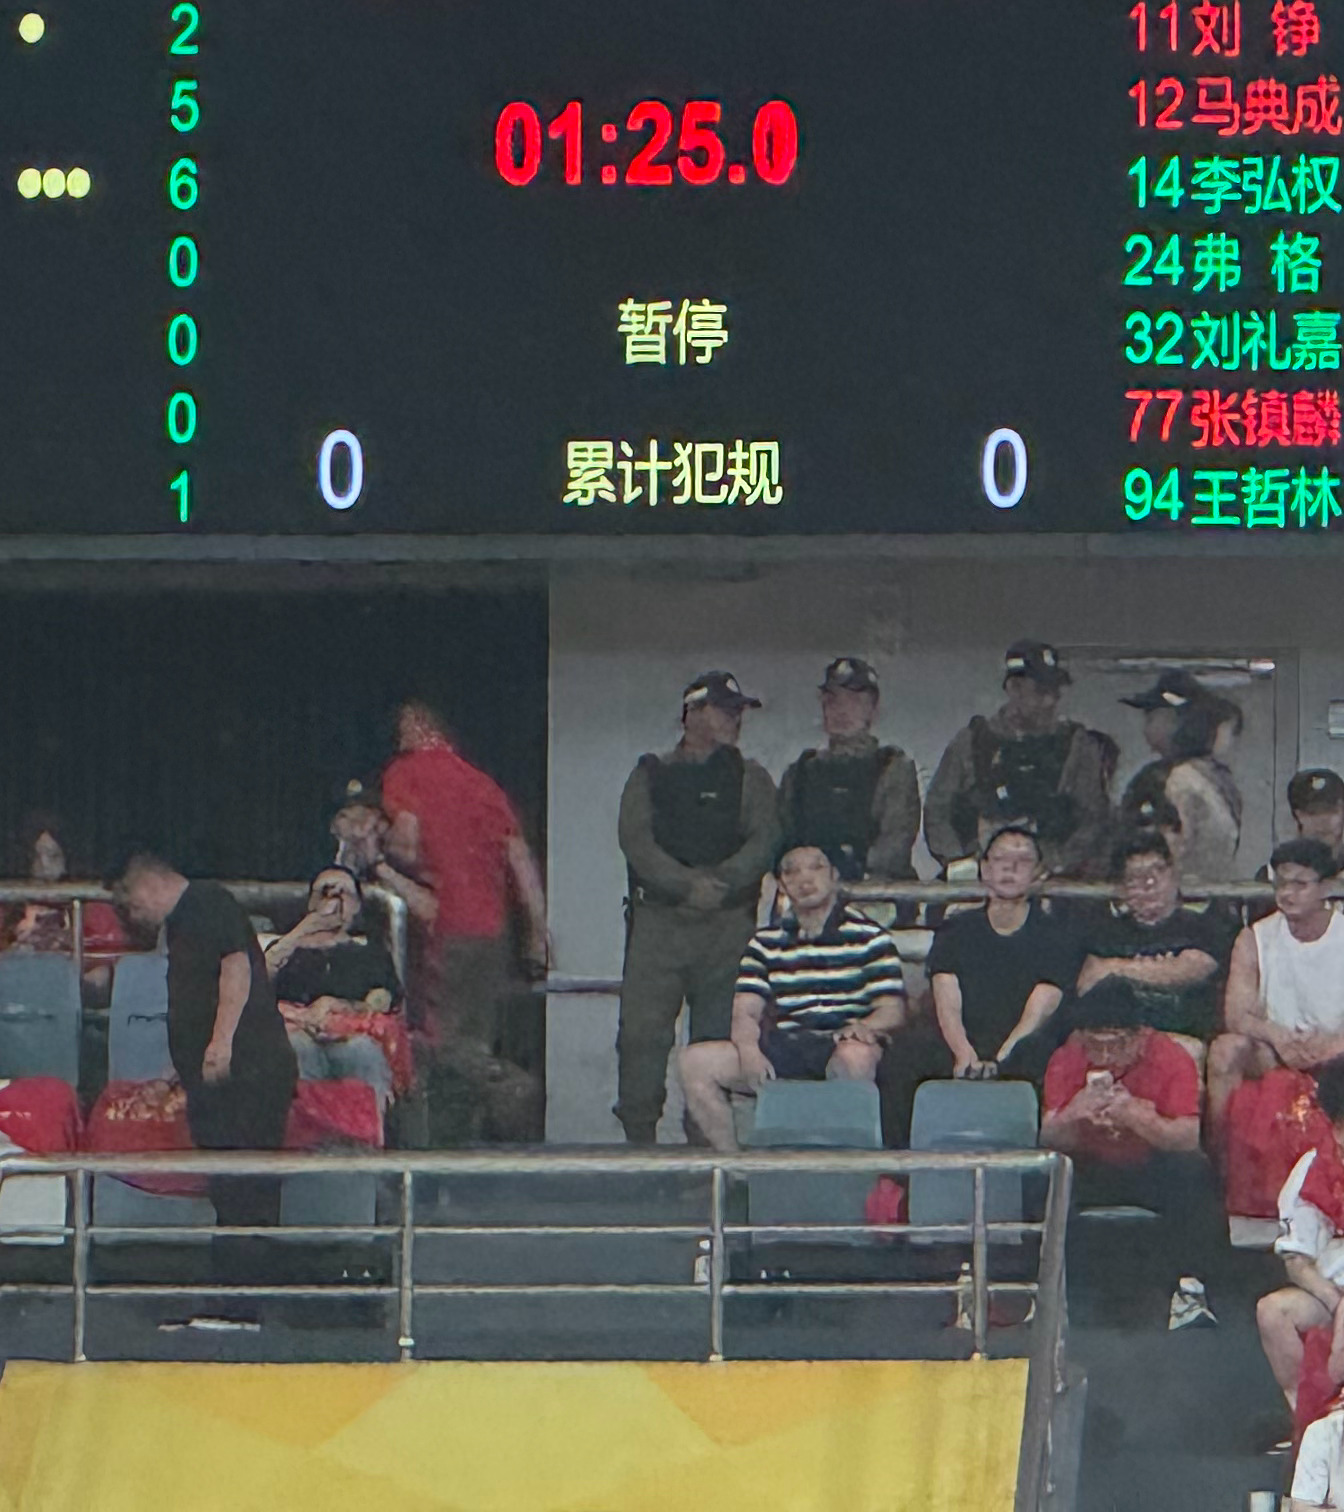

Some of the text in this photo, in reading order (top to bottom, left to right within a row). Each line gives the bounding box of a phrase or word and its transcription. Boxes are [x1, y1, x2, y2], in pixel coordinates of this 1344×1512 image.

[170, 3, 198, 54] 2
[171, 80, 199, 132] 5
[495, 99, 799, 187] 01:25.0
[170, 158, 198, 209] 6
[169, 236, 197, 287] 0
[168, 314, 197, 366] 0
[617, 297, 729, 366] 暂停
[168, 392, 196, 443] 0
[317, 427, 1028, 510] 0 累计犯规 0
[171, 470, 188, 522] 1
